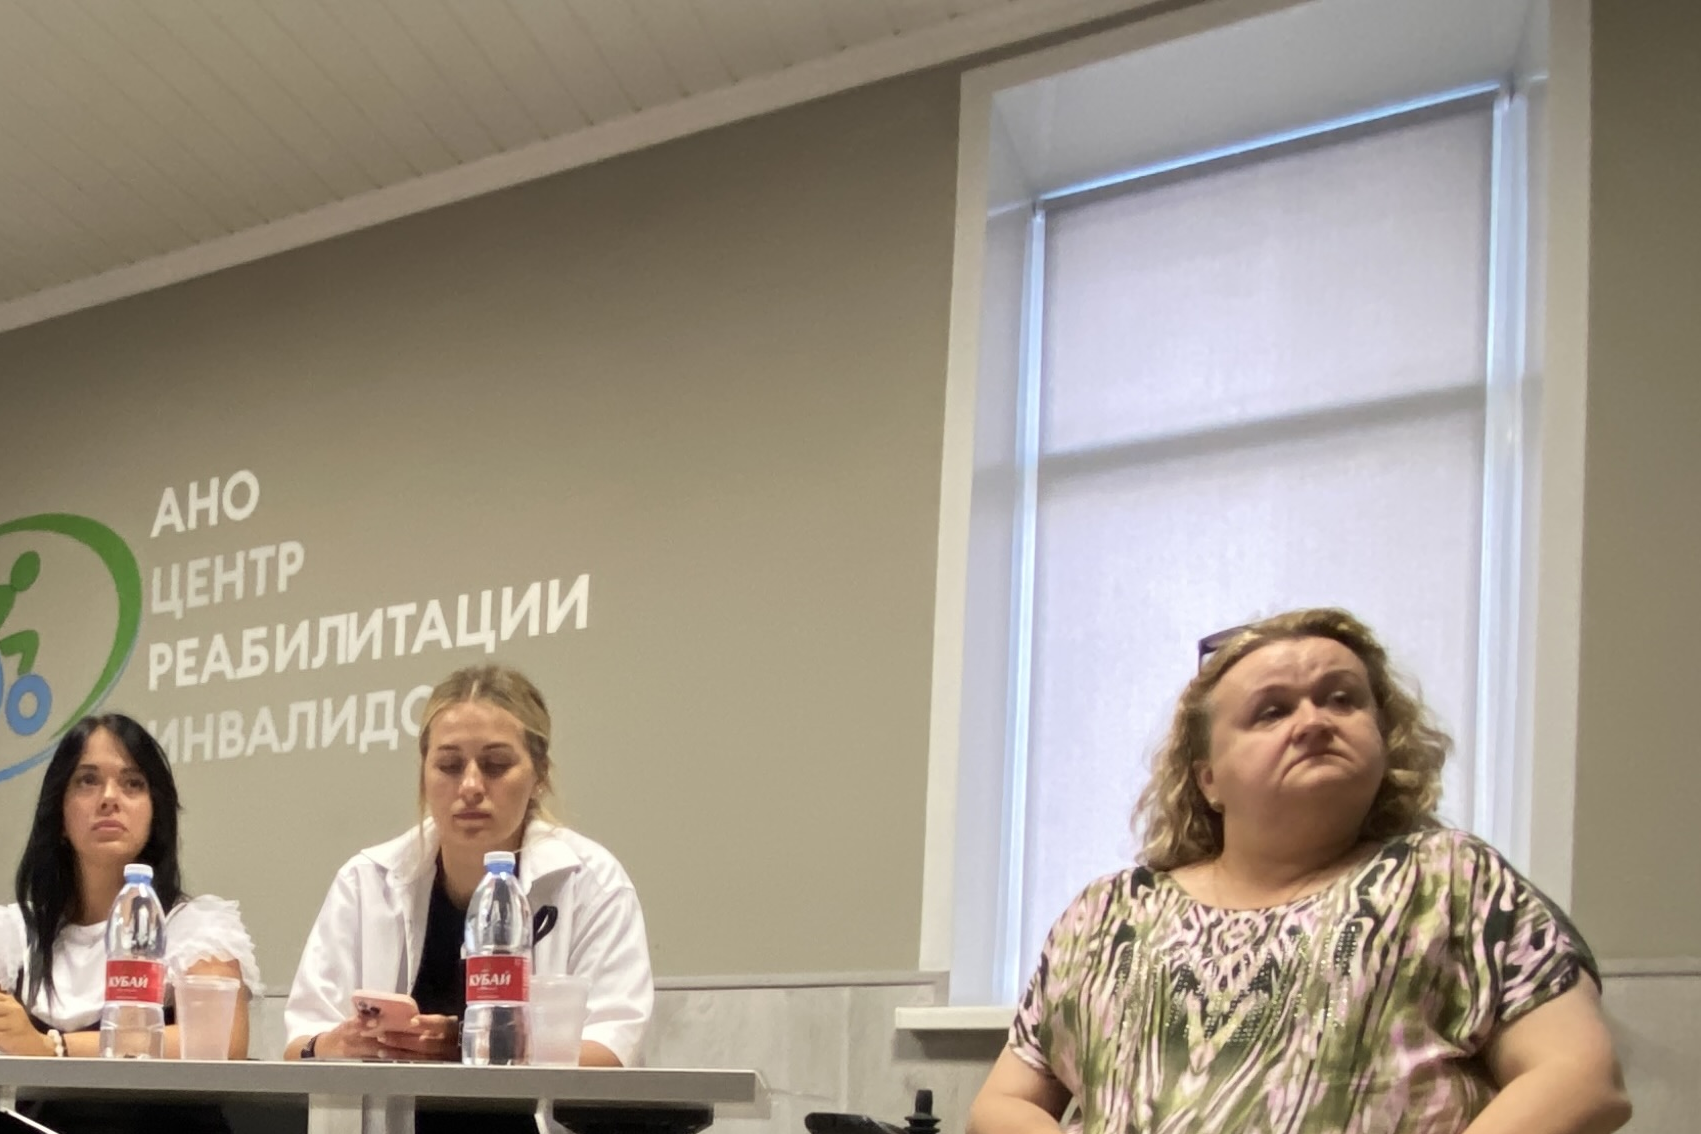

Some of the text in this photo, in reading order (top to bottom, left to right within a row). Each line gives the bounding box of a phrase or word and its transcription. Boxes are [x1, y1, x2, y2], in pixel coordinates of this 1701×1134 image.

[150, 469, 260, 538] АНО
[151, 541, 305, 619] ЦЕНТР
[148, 573, 591, 691] РЕАБИЛИТАЦИИ
[147, 684, 436, 765] ИНВАЛИДО
